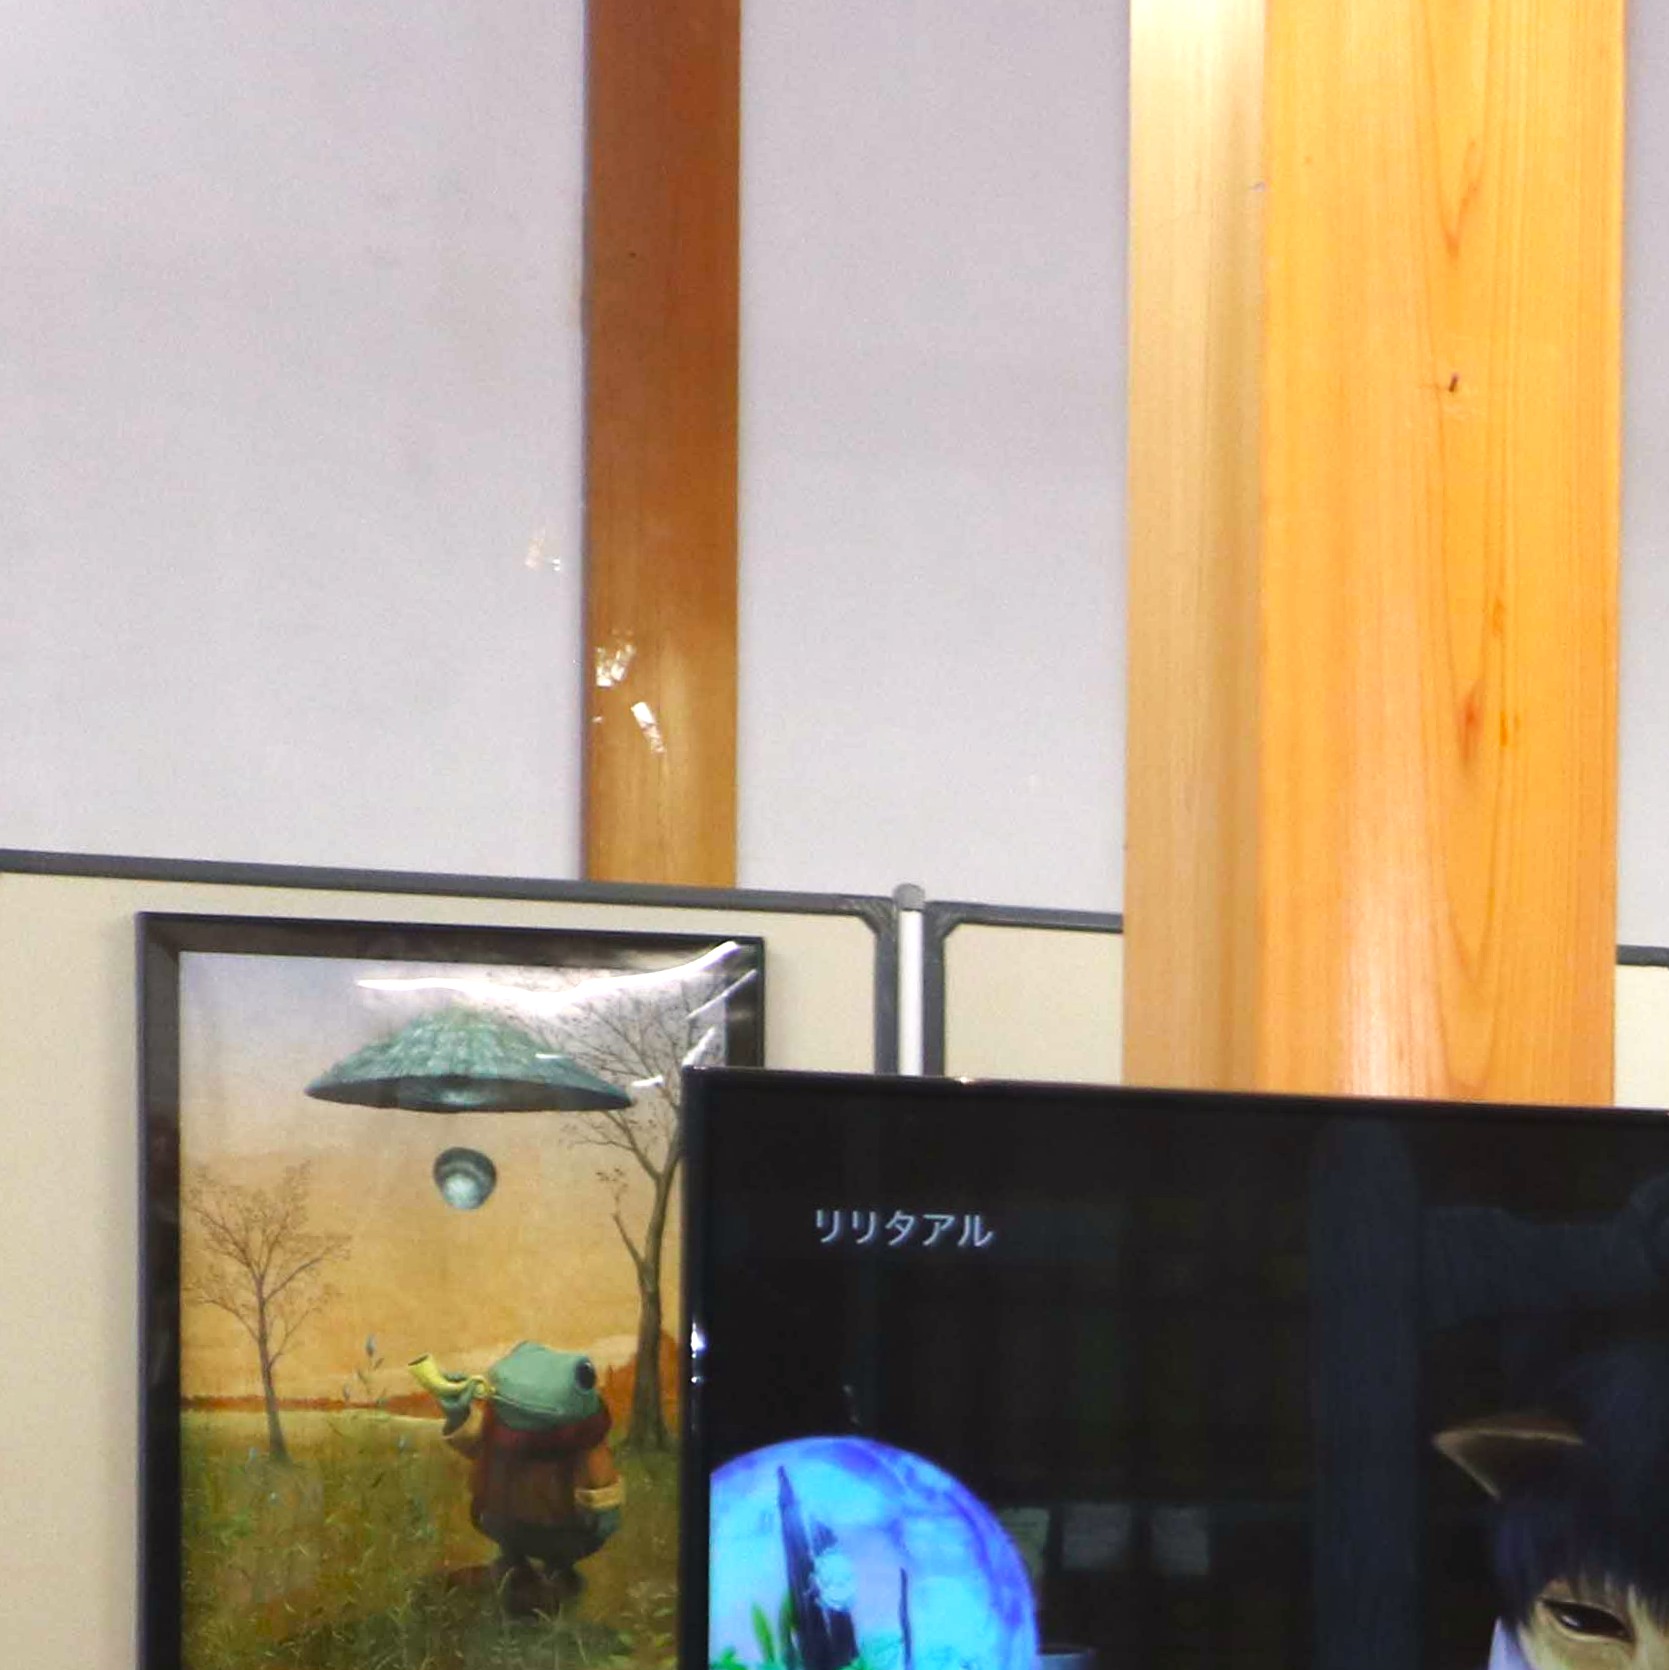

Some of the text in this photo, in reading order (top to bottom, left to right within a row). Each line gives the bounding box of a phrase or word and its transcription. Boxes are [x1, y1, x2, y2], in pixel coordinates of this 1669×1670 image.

[814, 1209, 995, 1247] リリタアル
